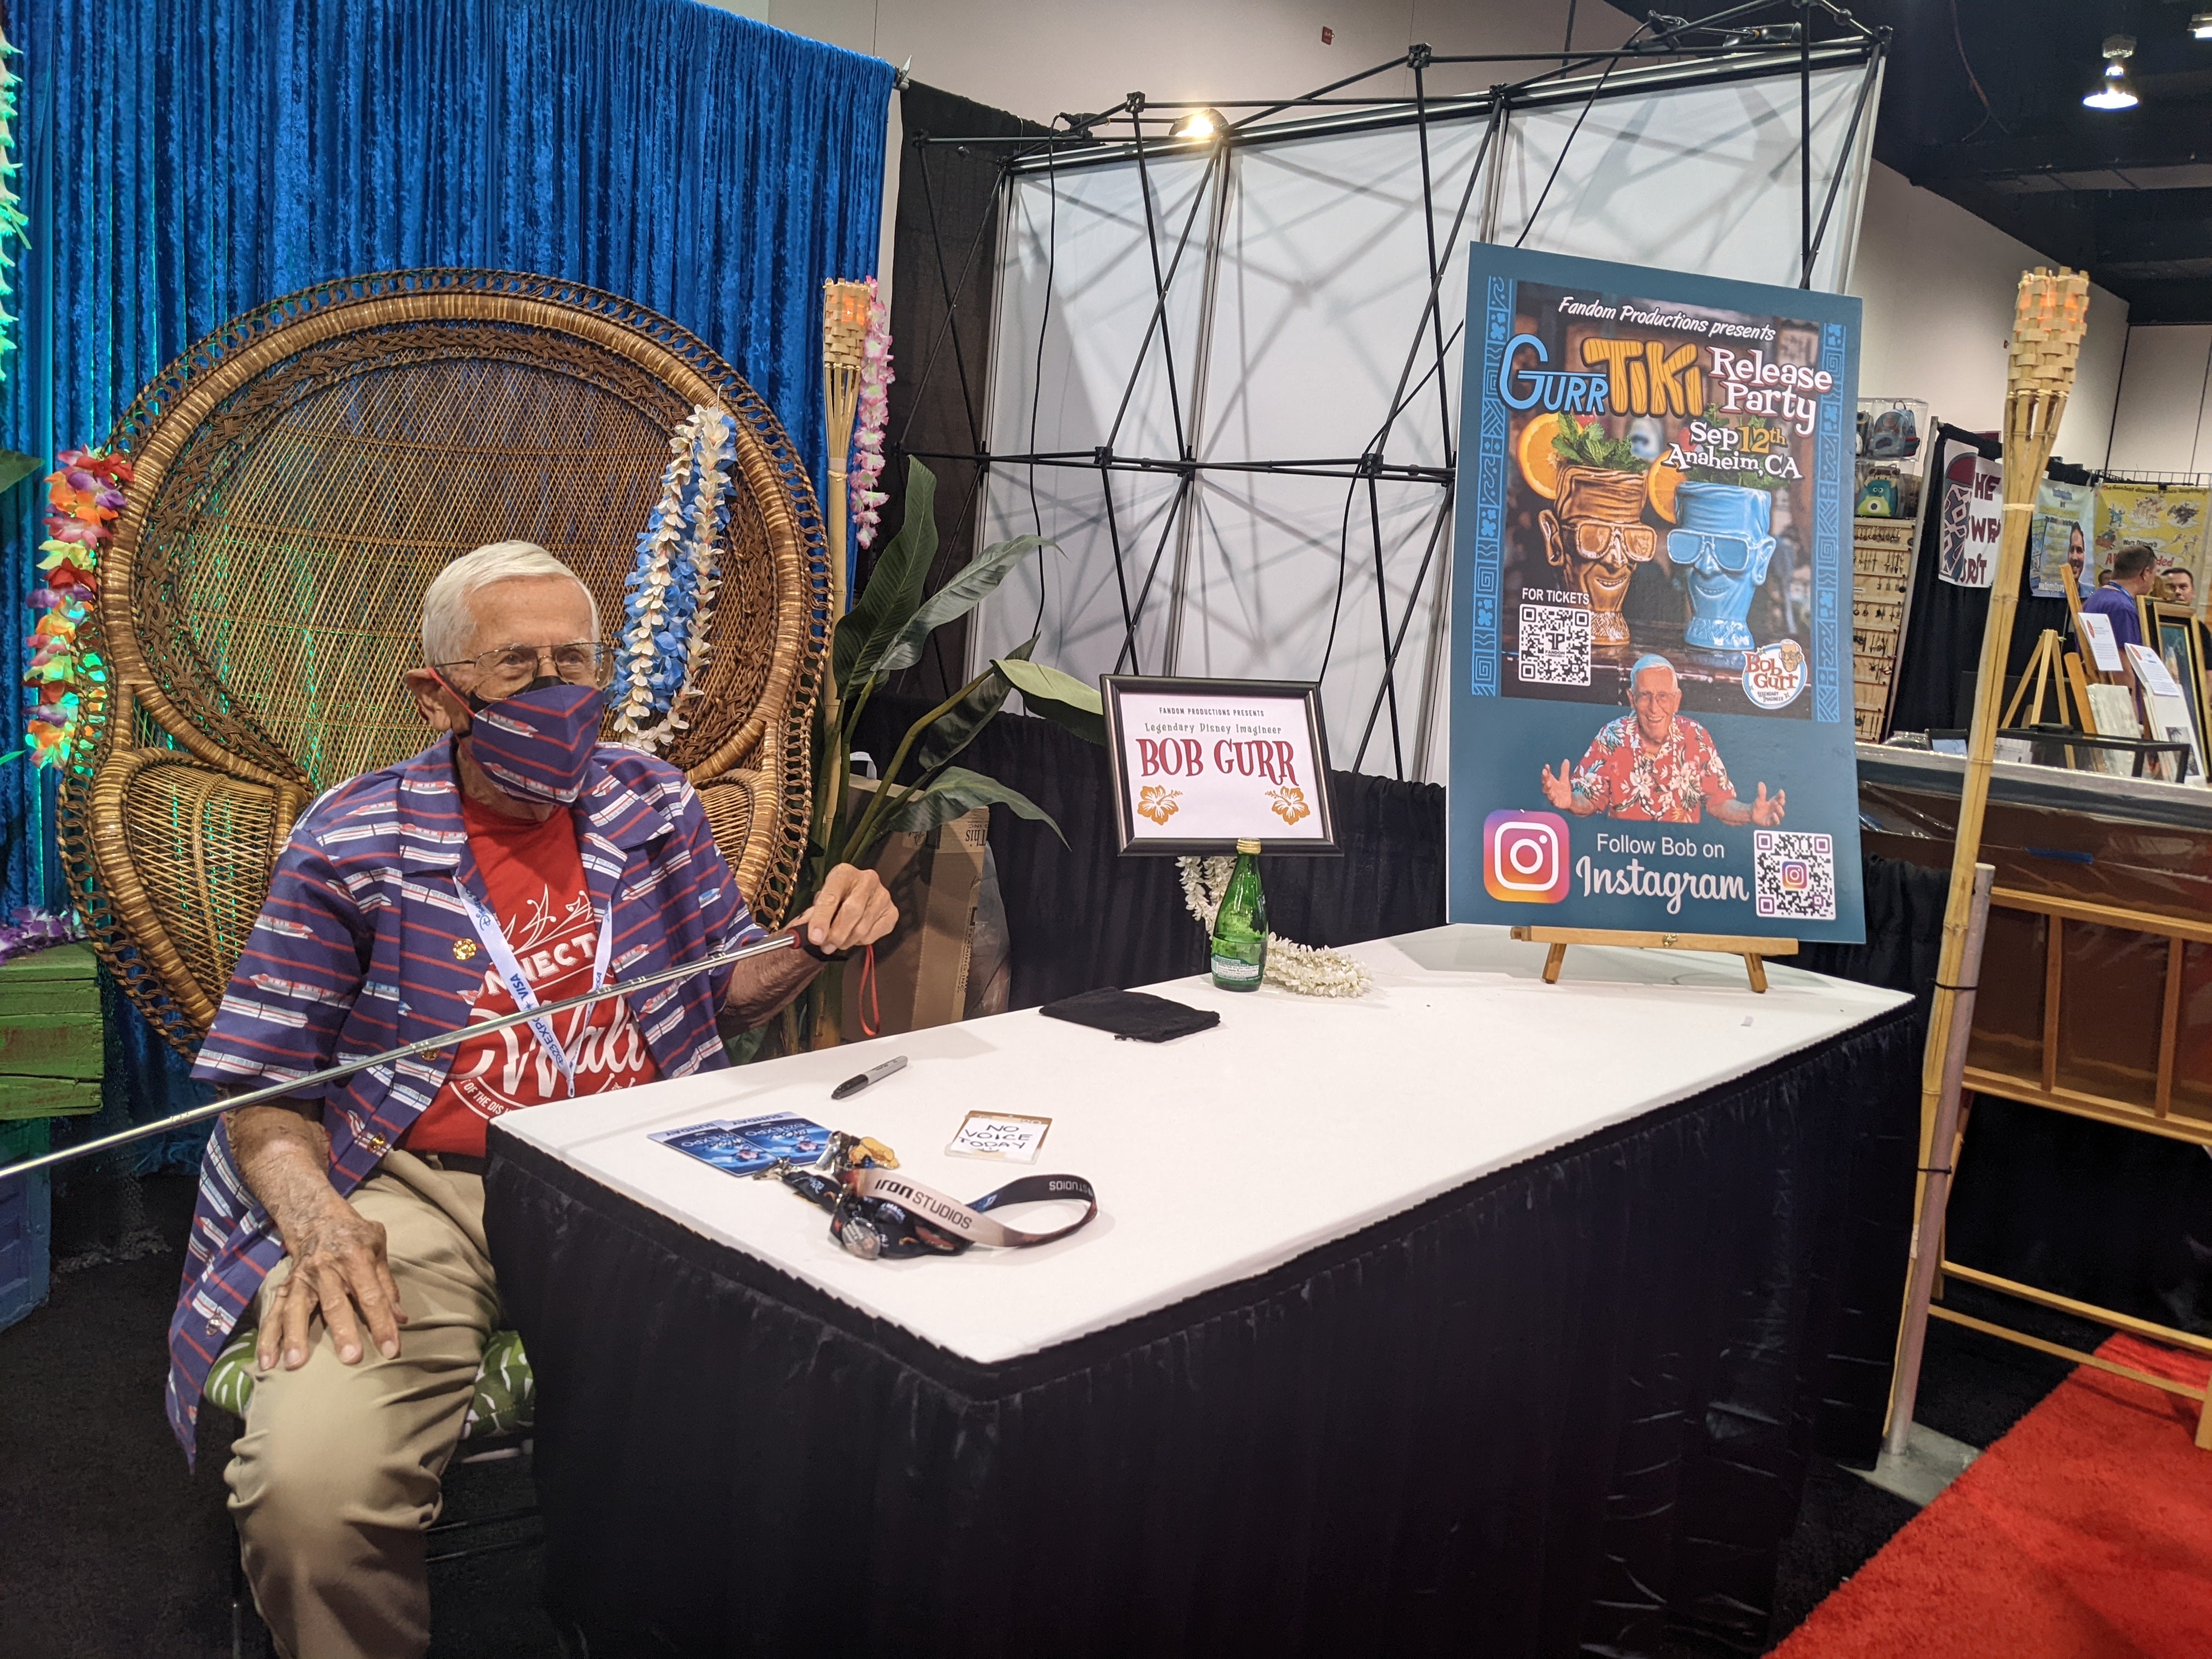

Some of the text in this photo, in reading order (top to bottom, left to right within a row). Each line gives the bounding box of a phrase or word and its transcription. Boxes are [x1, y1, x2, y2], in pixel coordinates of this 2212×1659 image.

[1558, 296, 1777, 341] Fandom Productions presents
[1705, 346, 1832, 393] Release
[1719, 381, 1817, 438] Party
[1690, 421, 1787, 454] Sep 12th
[1974, 472, 2002, 501] HE
[1522, 587, 1590, 605] FOR TICKETS
[1745, 652, 1782, 676] Bob
[1753, 672, 1799, 691] Gurr
[1188, 708, 1231, 716] PRODUCTIONS
[1144, 722, 1282, 736] Legendary Disney Imagineer
[1135, 737, 1300, 787] BOB GURR
[966, 829, 986, 847] This
[1597, 833, 1725, 859] Follow Bob on
[1575, 855, 1750, 915] Instagram
[510, 973, 529, 1002] VISA
[465, 1082, 476, 1094] OF
[477, 1090, 493, 1109] THE
[958, 1137, 1026, 1149] TODAY
[964, 1128, 1034, 1141] VOICE
[912, 1191, 973, 1229] STUDIOS
